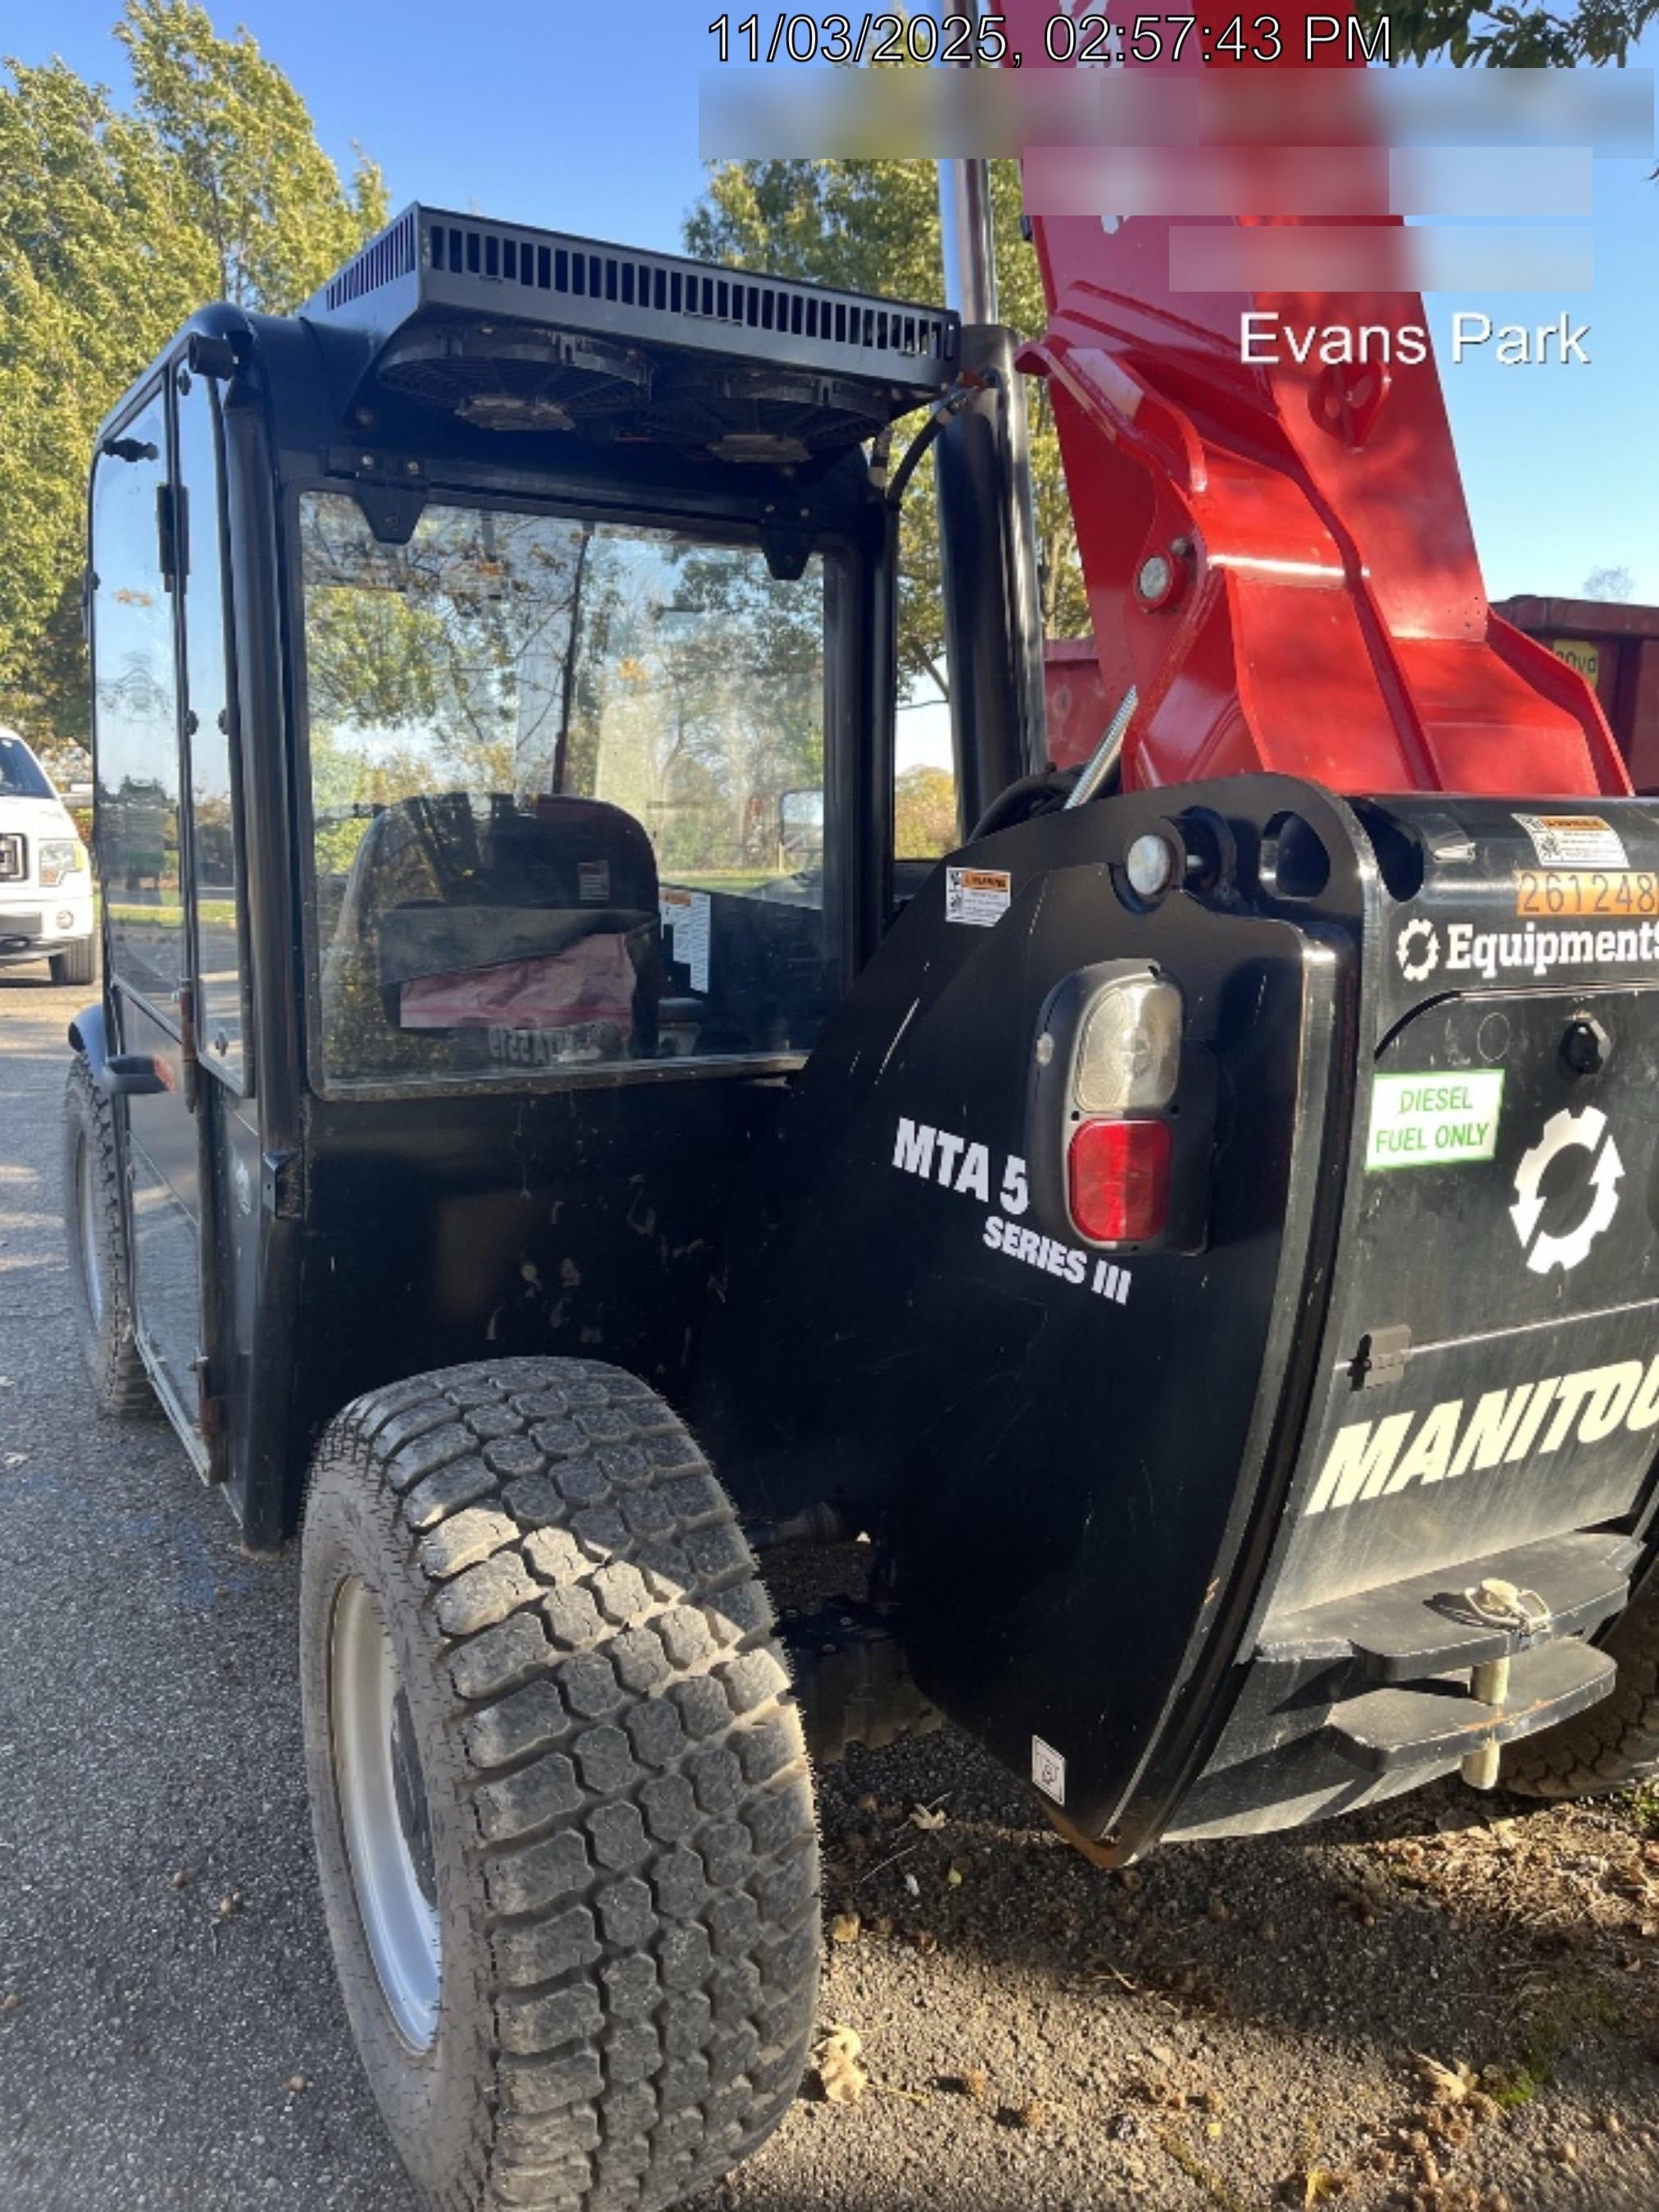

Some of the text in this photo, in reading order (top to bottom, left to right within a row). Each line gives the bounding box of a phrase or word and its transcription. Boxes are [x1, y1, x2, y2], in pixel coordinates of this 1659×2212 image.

[1520, 872, 1656, 913] 261248
[1446, 921, 1659, 979] Equipment
[1399, 1086, 1474, 1114] DIESEL
[892, 1117, 990, 1203] MTA
[1376, 1122, 1490, 1154] FUEL ONLY
[982, 1216, 1132, 1306] SERIES III
